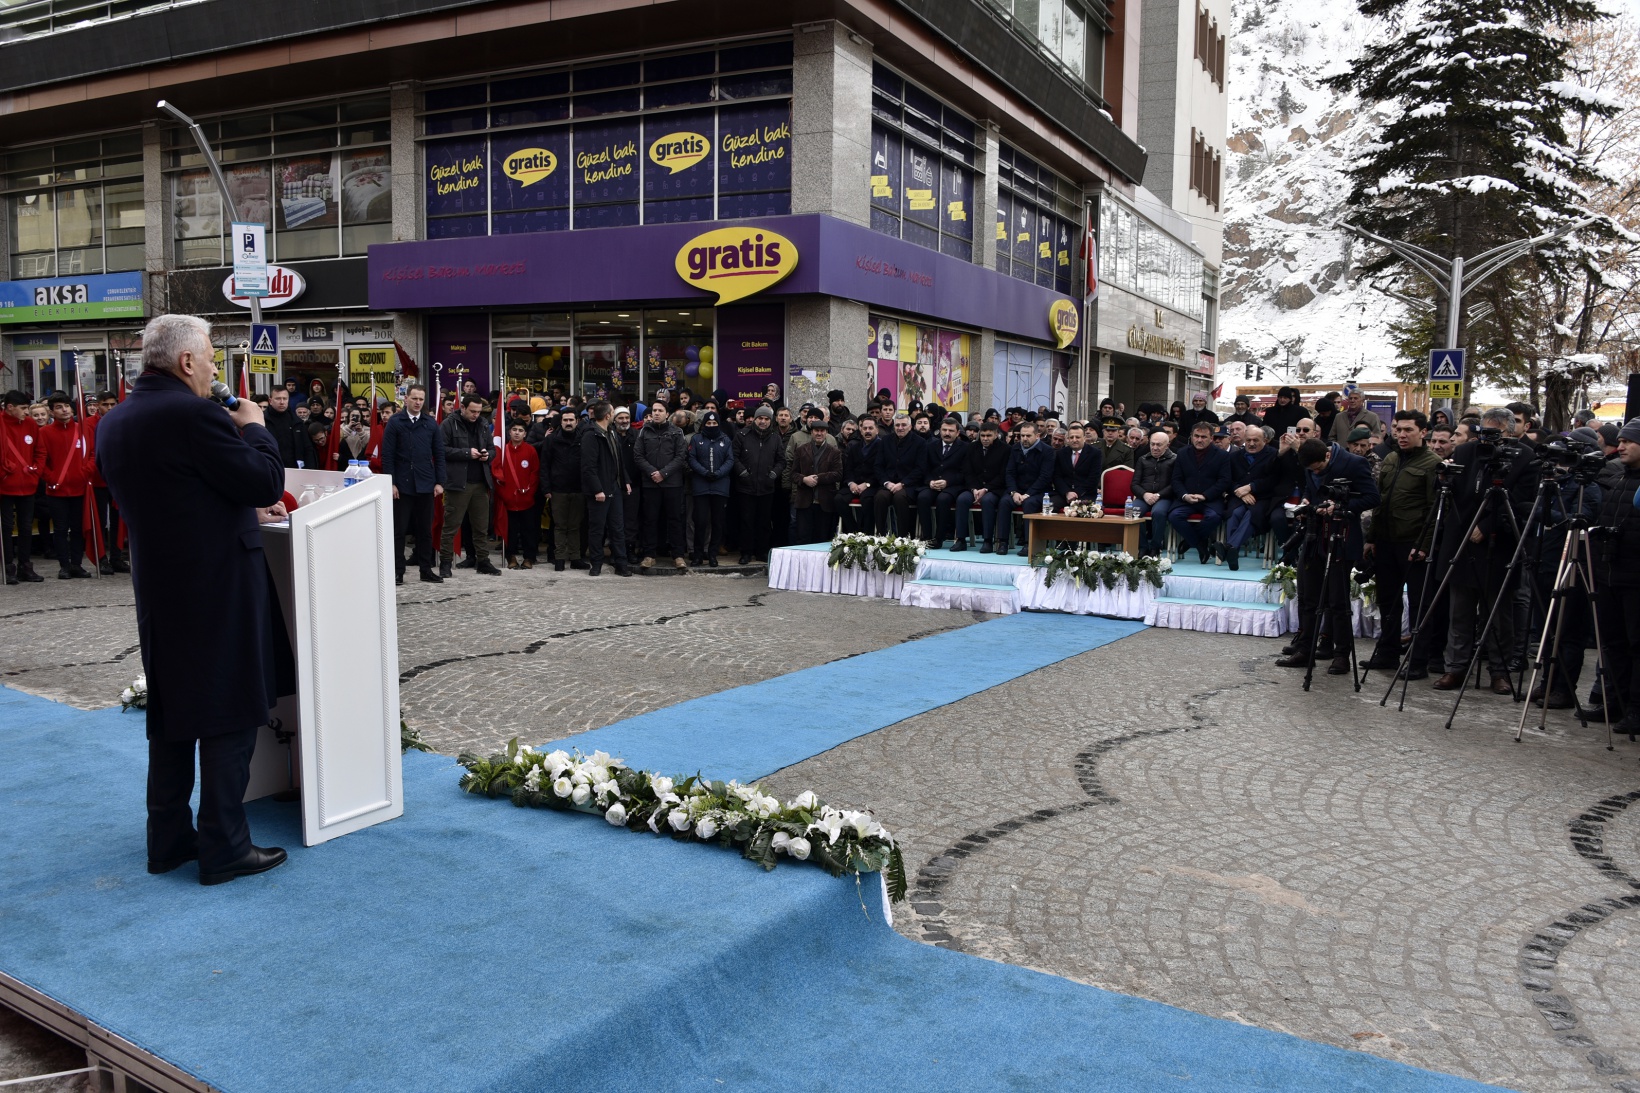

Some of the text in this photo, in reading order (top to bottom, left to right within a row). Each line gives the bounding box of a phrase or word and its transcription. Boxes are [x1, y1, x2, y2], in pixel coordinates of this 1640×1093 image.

[722, 122, 791, 152] Güzel bak
[577, 141, 637, 169] Güzel bak
[655, 135, 704, 161] gratis
[730, 146, 785, 169] kendine
[430, 155, 484, 181] Güzel bak
[508, 151, 551, 175] gratis
[584, 163, 633, 184] kendine
[437, 175, 479, 195] kendine
[245, 234, 253, 244] P
[687, 233, 782, 280] gratis
[36, 284, 88, 306] aksa
[1057, 306, 1077, 331] gratis
[306, 328, 327, 338] NBB
[346, 326, 373, 337] aydoğan
[374, 330, 393, 340] DOR
[358, 352, 386, 364] SEZONU
[587, 364, 612, 377] florma
[1433, 383, 1450, 391] İLK
